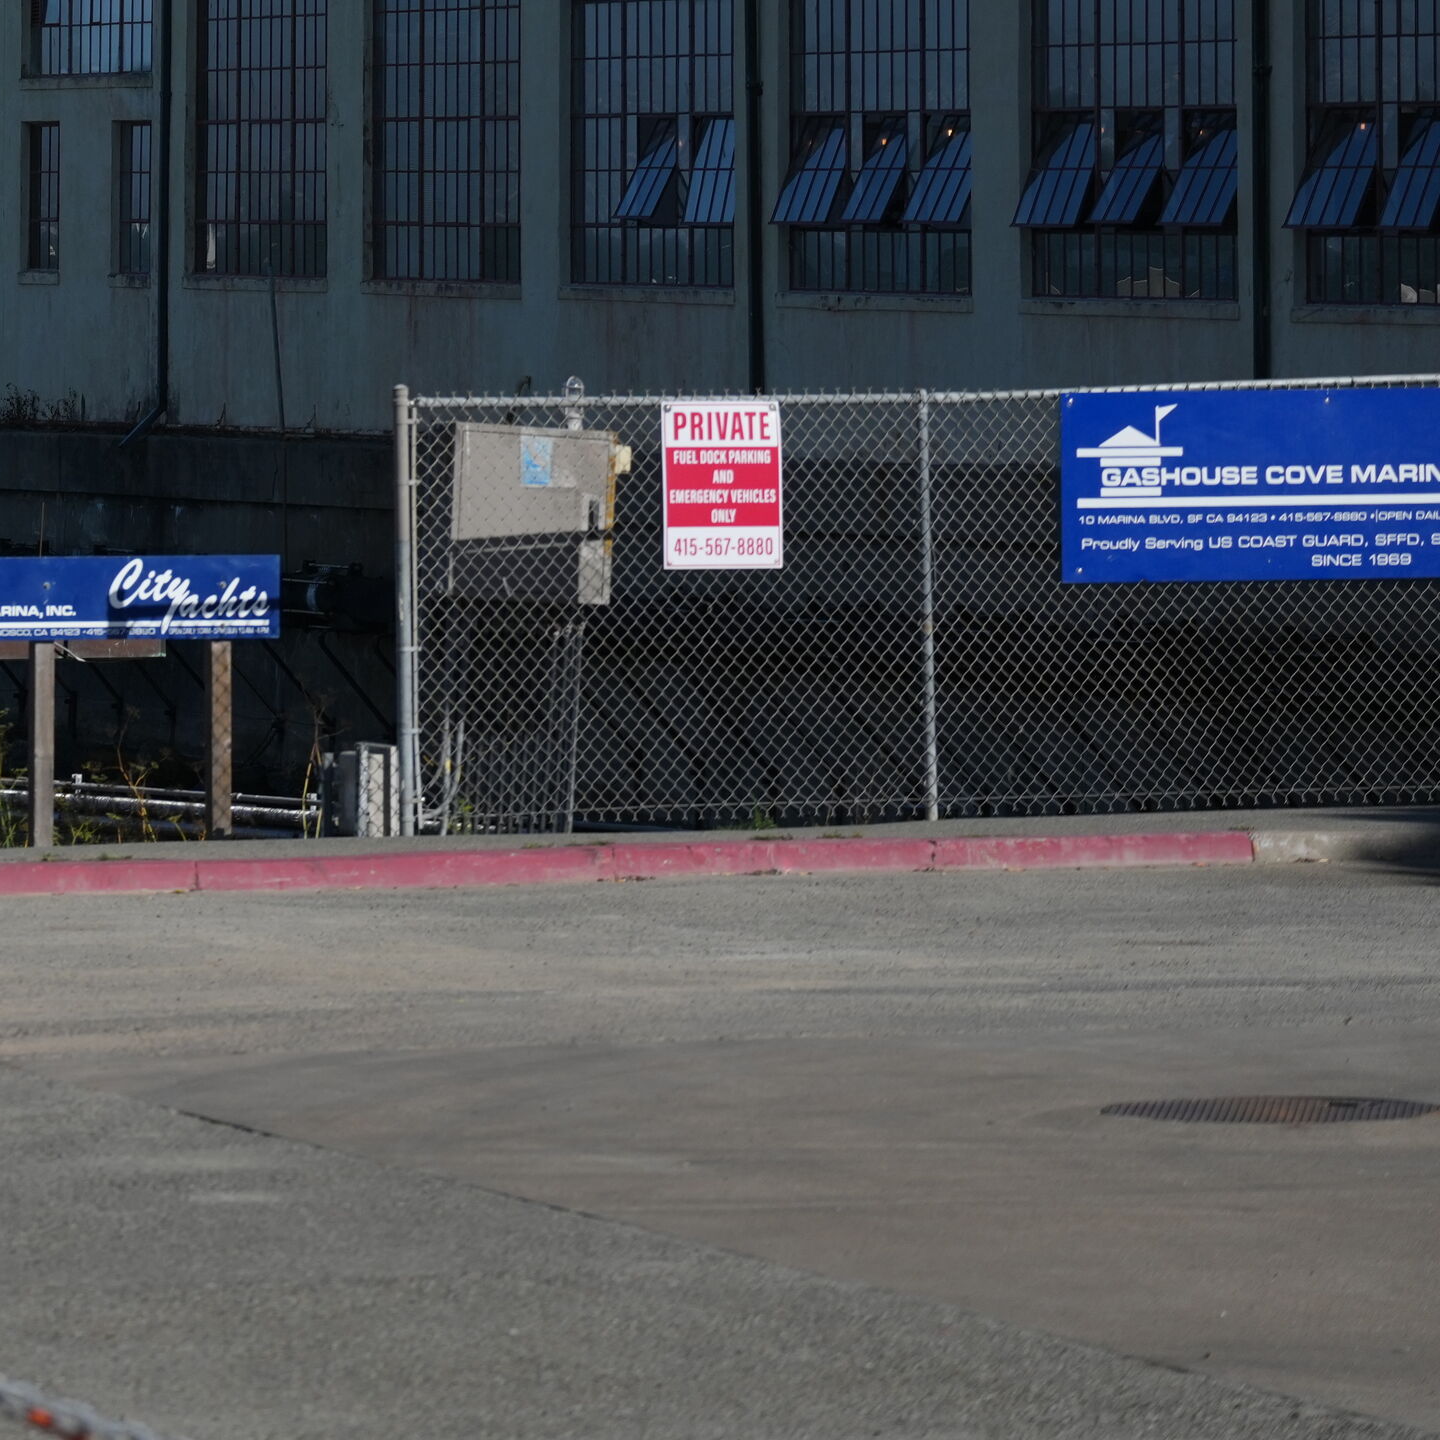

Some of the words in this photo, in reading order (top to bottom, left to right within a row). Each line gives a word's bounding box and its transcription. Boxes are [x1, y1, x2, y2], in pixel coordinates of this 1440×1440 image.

[673, 411, 771, 441] PRIVATE
[673, 449, 698, 465] FUEL
[700, 449, 727, 465] DOCK
[728, 449, 771, 464] PARKING
[712, 469, 734, 484] AND
[1101, 466, 1258, 487] GASHOUSE
[1265, 464, 1344, 485] COVE
[670, 489, 729, 504] EMERGENCY
[730, 488, 777, 503] VEHICLES
[711, 508, 736, 524] ONLY
[1078, 515, 1095, 525] 10
[1097, 514, 1146, 525] MARINA
[1149, 514, 1184, 525] BLVD,
[1187, 513, 1203, 524] SF
[1206, 513, 1224, 524] CA
[1227, 512, 1268, 523] 94123
[1278, 511, 1367, 523] 415-567-8880
[674, 537, 774, 556] 415-567-8880
[1081, 537, 1140, 552] Proudly
[1145, 536, 1204, 551] Serving
[1208, 536, 1233, 549] US
[1238, 535, 1298, 549] COAST
[1302, 533, 1369, 548] GUARD,
[1375, 533, 1425, 547] SFFD,
[1311, 553, 1362, 567] SINCE
[1369, 553, 1412, 566] 1969
[108, 558, 190, 634] City
[45, 604, 76, 617] INC.
[33, 628, 48, 637] CA
